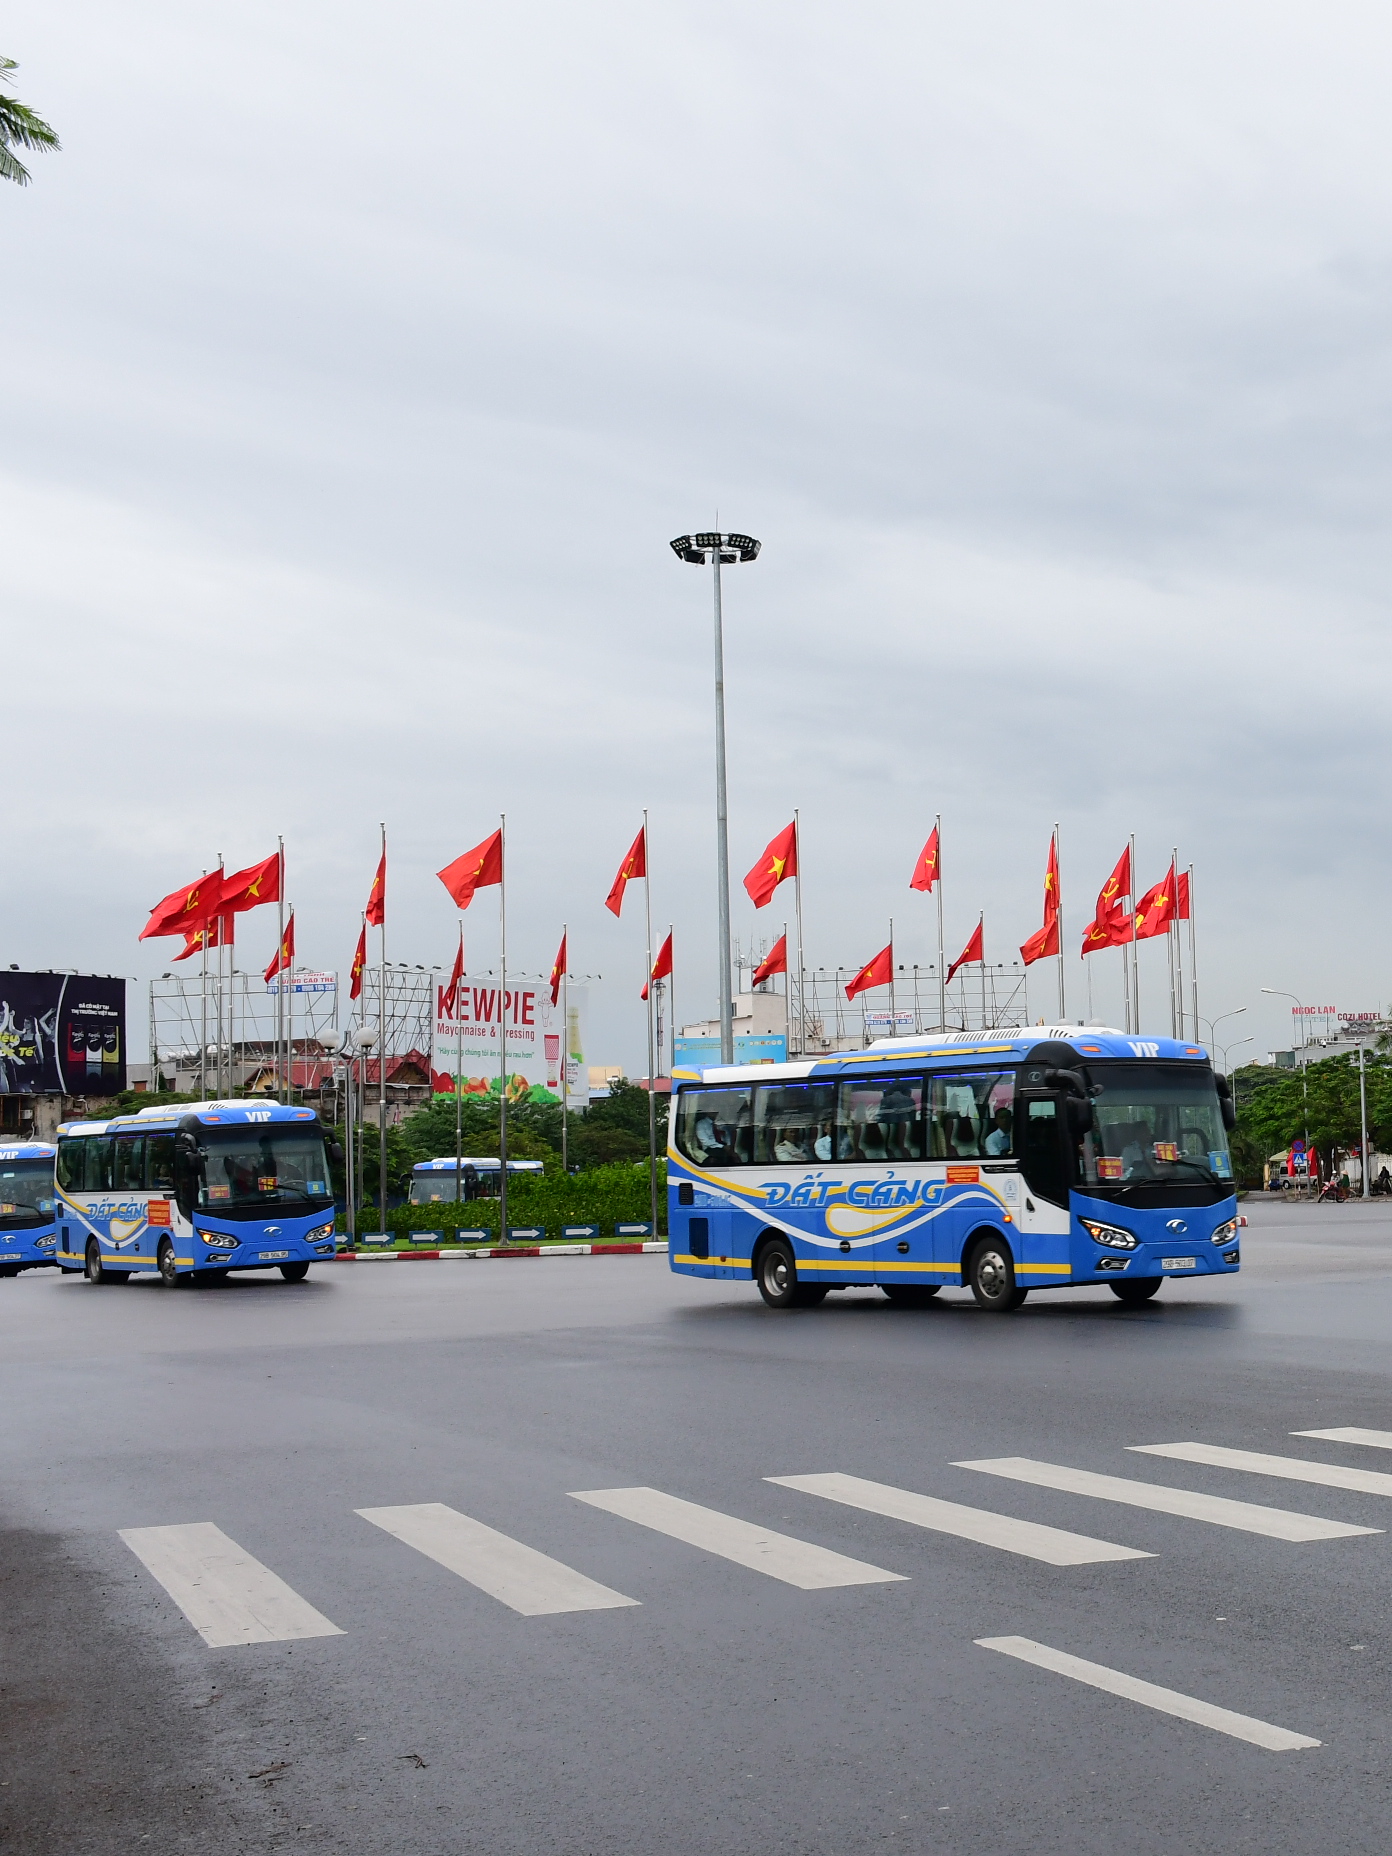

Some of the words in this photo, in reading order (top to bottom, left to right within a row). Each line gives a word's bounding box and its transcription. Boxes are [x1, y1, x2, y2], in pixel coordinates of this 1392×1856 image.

[437, 985, 536, 1025] KEWPIE
[1318, 1006, 1336, 1014] LAN
[1358, 1012, 1382, 1020] HOTEL
[490, 1026, 496, 1038] &
[500, 1028, 535, 1042] ressing
[1128, 1042, 1160, 1058] VIP
[244, 1110, 272, 1122] VIP
[0, 1151, 19, 1160] VIP
[758, 1172, 843, 1206] ĐẤT
[846, 1170, 947, 1206] CẢNG
[86, 1198, 117, 1220] ĐẤT
